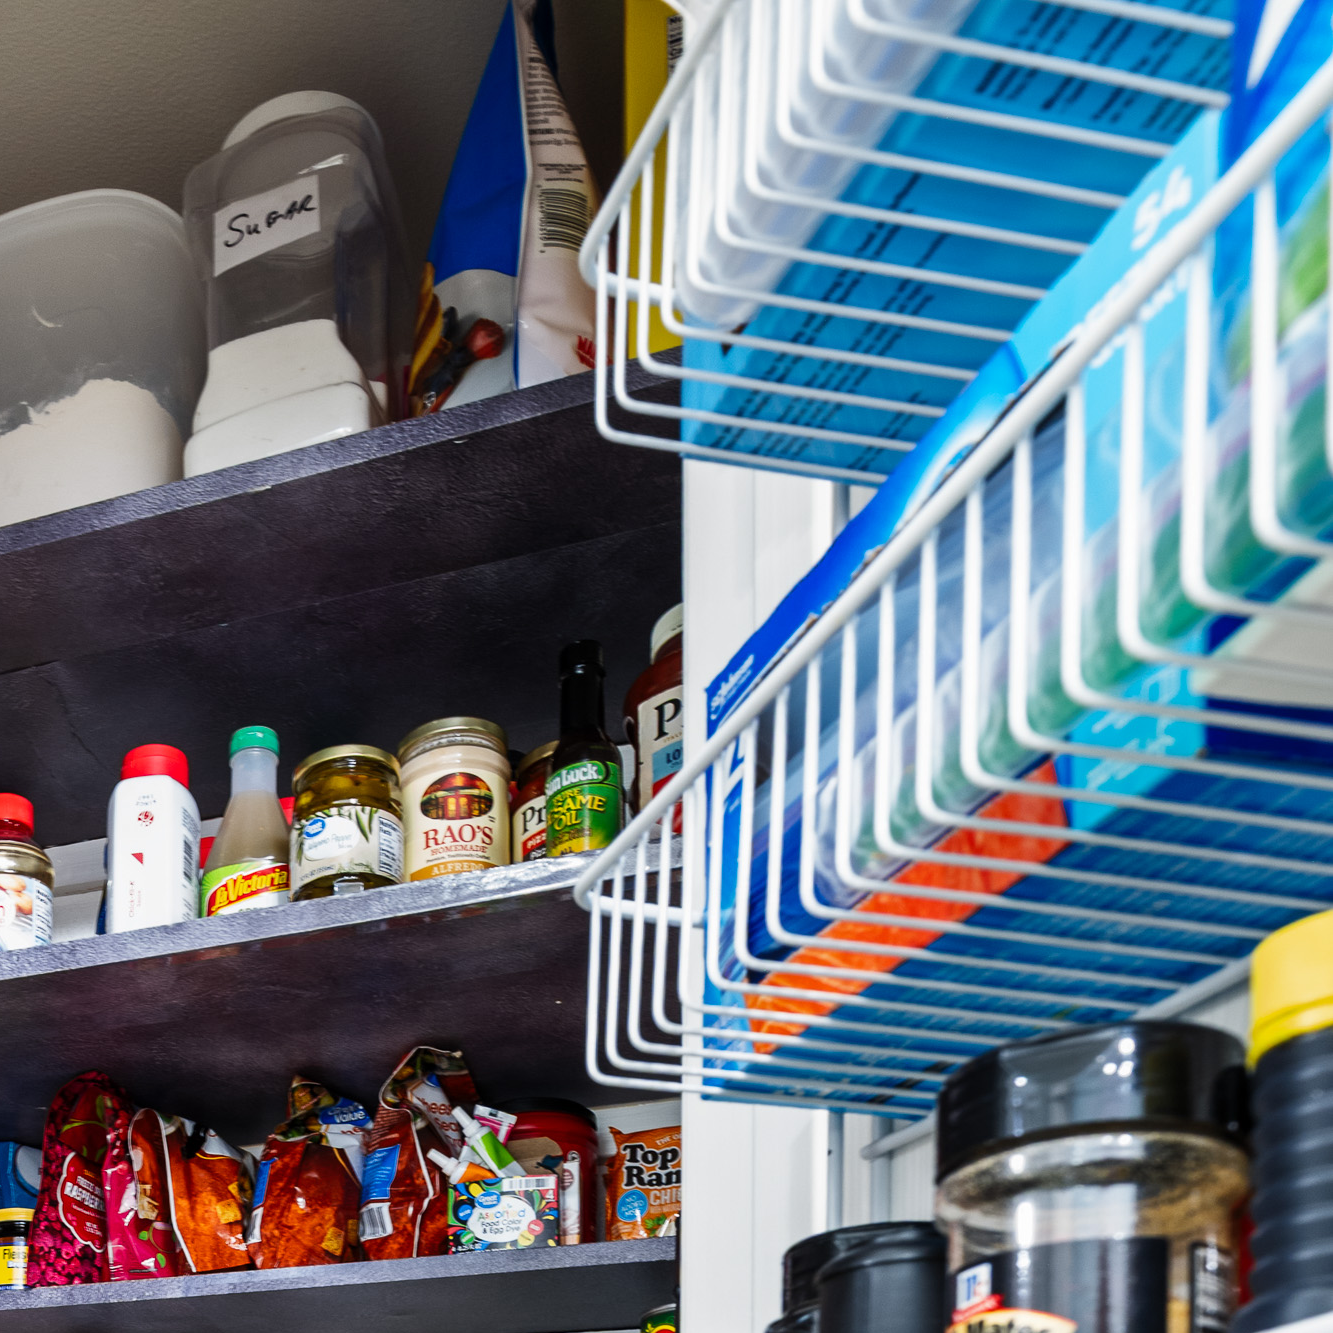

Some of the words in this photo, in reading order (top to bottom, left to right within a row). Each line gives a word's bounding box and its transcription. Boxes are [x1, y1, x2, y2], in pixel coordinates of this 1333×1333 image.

[223, 192, 319, 248] SUGAR
[553, 811, 582, 831] OIL
[423, 824, 494, 850] RAO'S
[621, 1143, 680, 1169] Top
